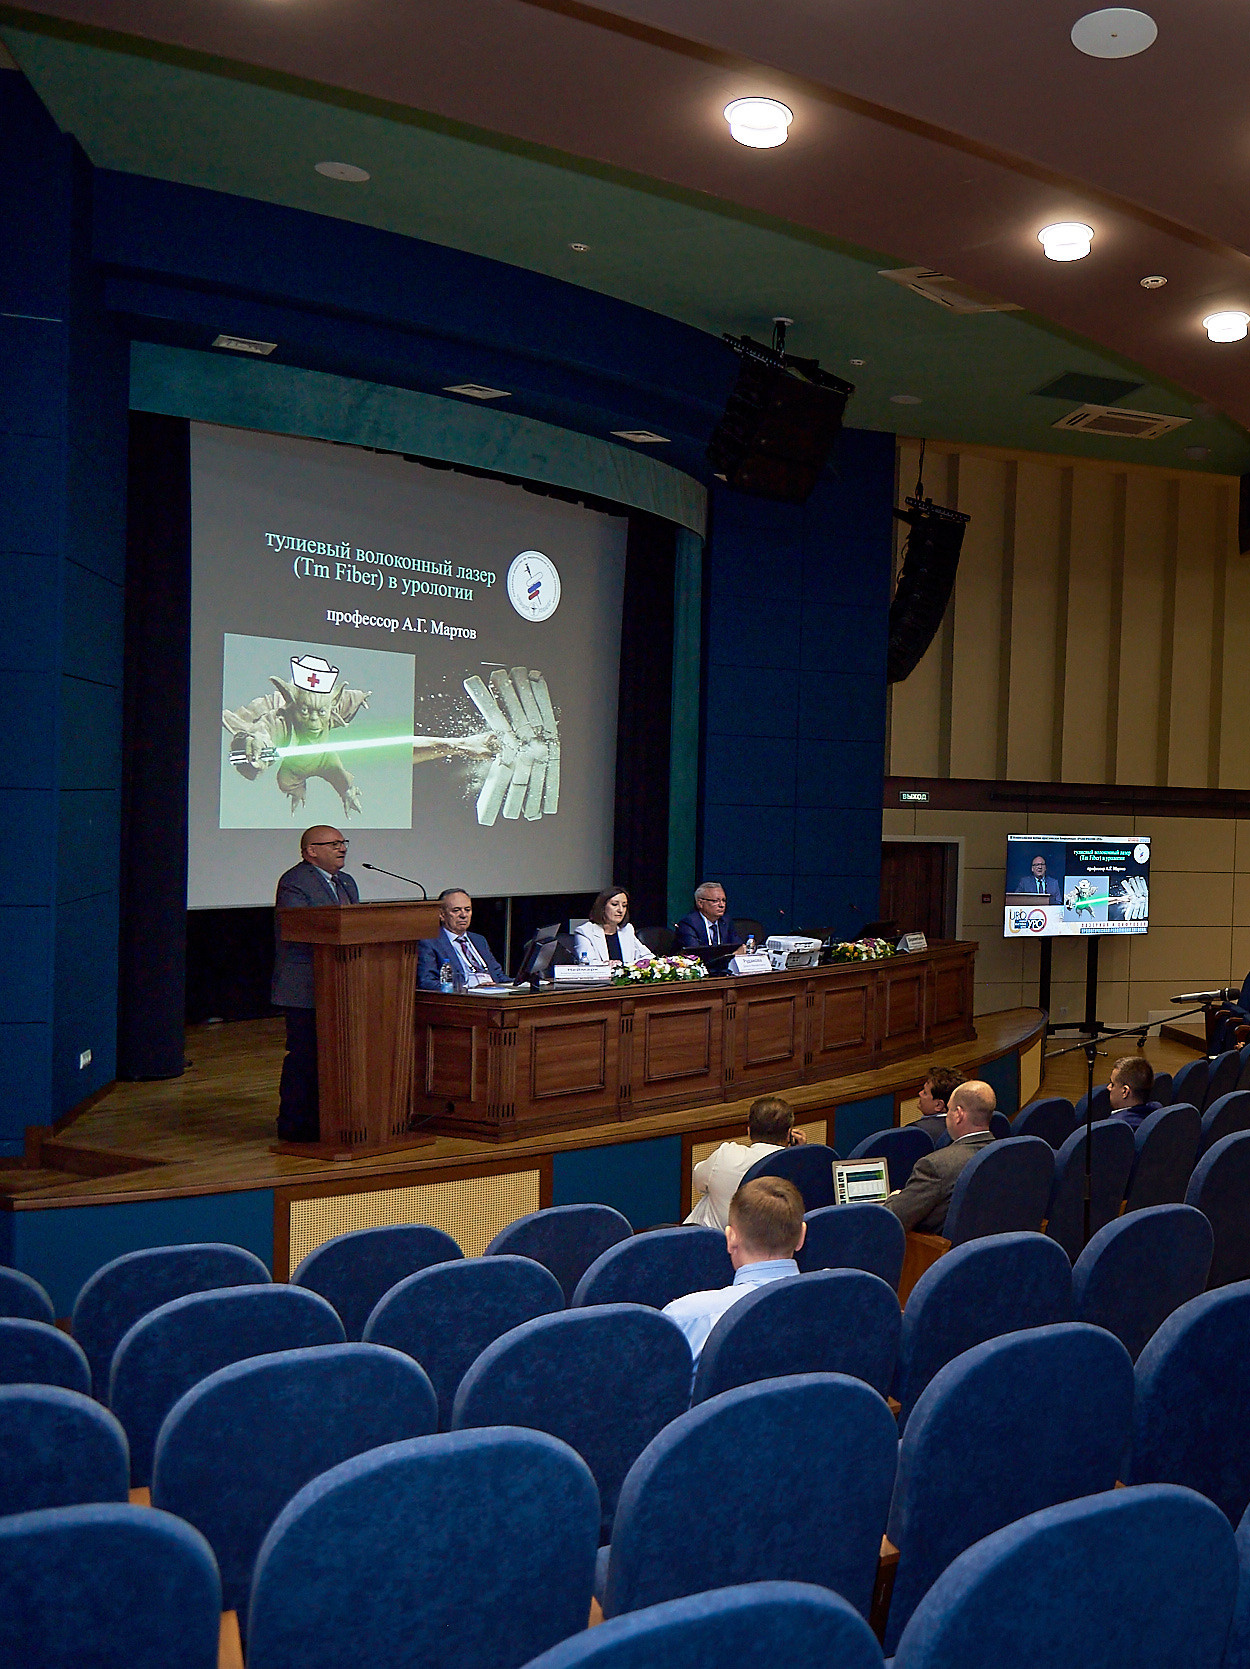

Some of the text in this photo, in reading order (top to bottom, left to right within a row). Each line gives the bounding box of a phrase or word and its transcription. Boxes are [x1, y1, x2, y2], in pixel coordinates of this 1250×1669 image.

[265, 532, 351, 560] тулиевый
[356, 548, 453, 577] волоконный
[456, 566, 496, 588] лазер
[293, 556, 473, 601] (Tm Fiber) в урологии
[326, 609, 477, 640] профессор А.Г. Мартов
